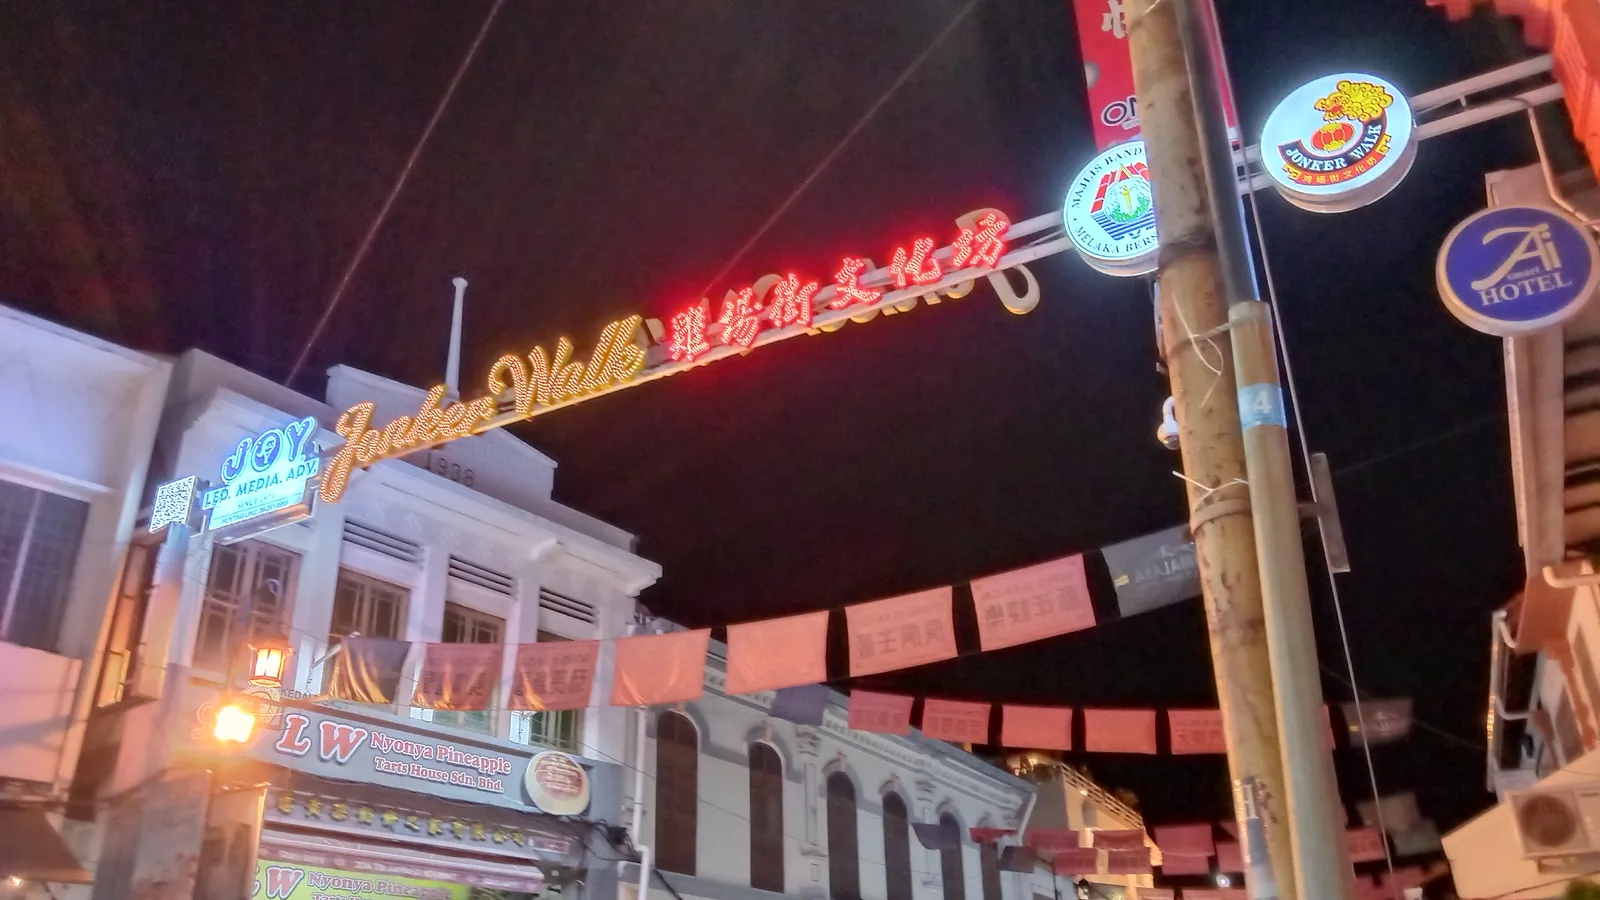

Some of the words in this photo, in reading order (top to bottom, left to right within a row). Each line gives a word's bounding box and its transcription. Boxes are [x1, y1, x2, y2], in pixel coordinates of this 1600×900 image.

[1286, 148, 1347, 171] JONKER
[1349, 124, 1382, 160] WALK
[1071, 165, 1103, 209] MAJLIS
[1104, 146, 1145, 166] BAND
[1074, 226, 1120, 253] MELAKA
[1478, 272, 1573, 306] HOTEL
[488, 314, 646, 417] Walk
[1252, 390, 1273, 414] 4
[221, 416, 317, 484] JOY
[204, 488, 232, 507] LED.
[236, 473, 283, 497] MEDIA.
[286, 460, 318, 482] ADV.
[370, 731, 433, 759] Nyonya
[437, 744, 512, 775] Pineapple
[375, 757, 408, 774] Tarts
[409, 763, 449, 782] House
[450, 771, 476, 786] Sdn.
[478, 776, 504, 793] Bhd.
[308, 871, 373, 894] Nyonya
